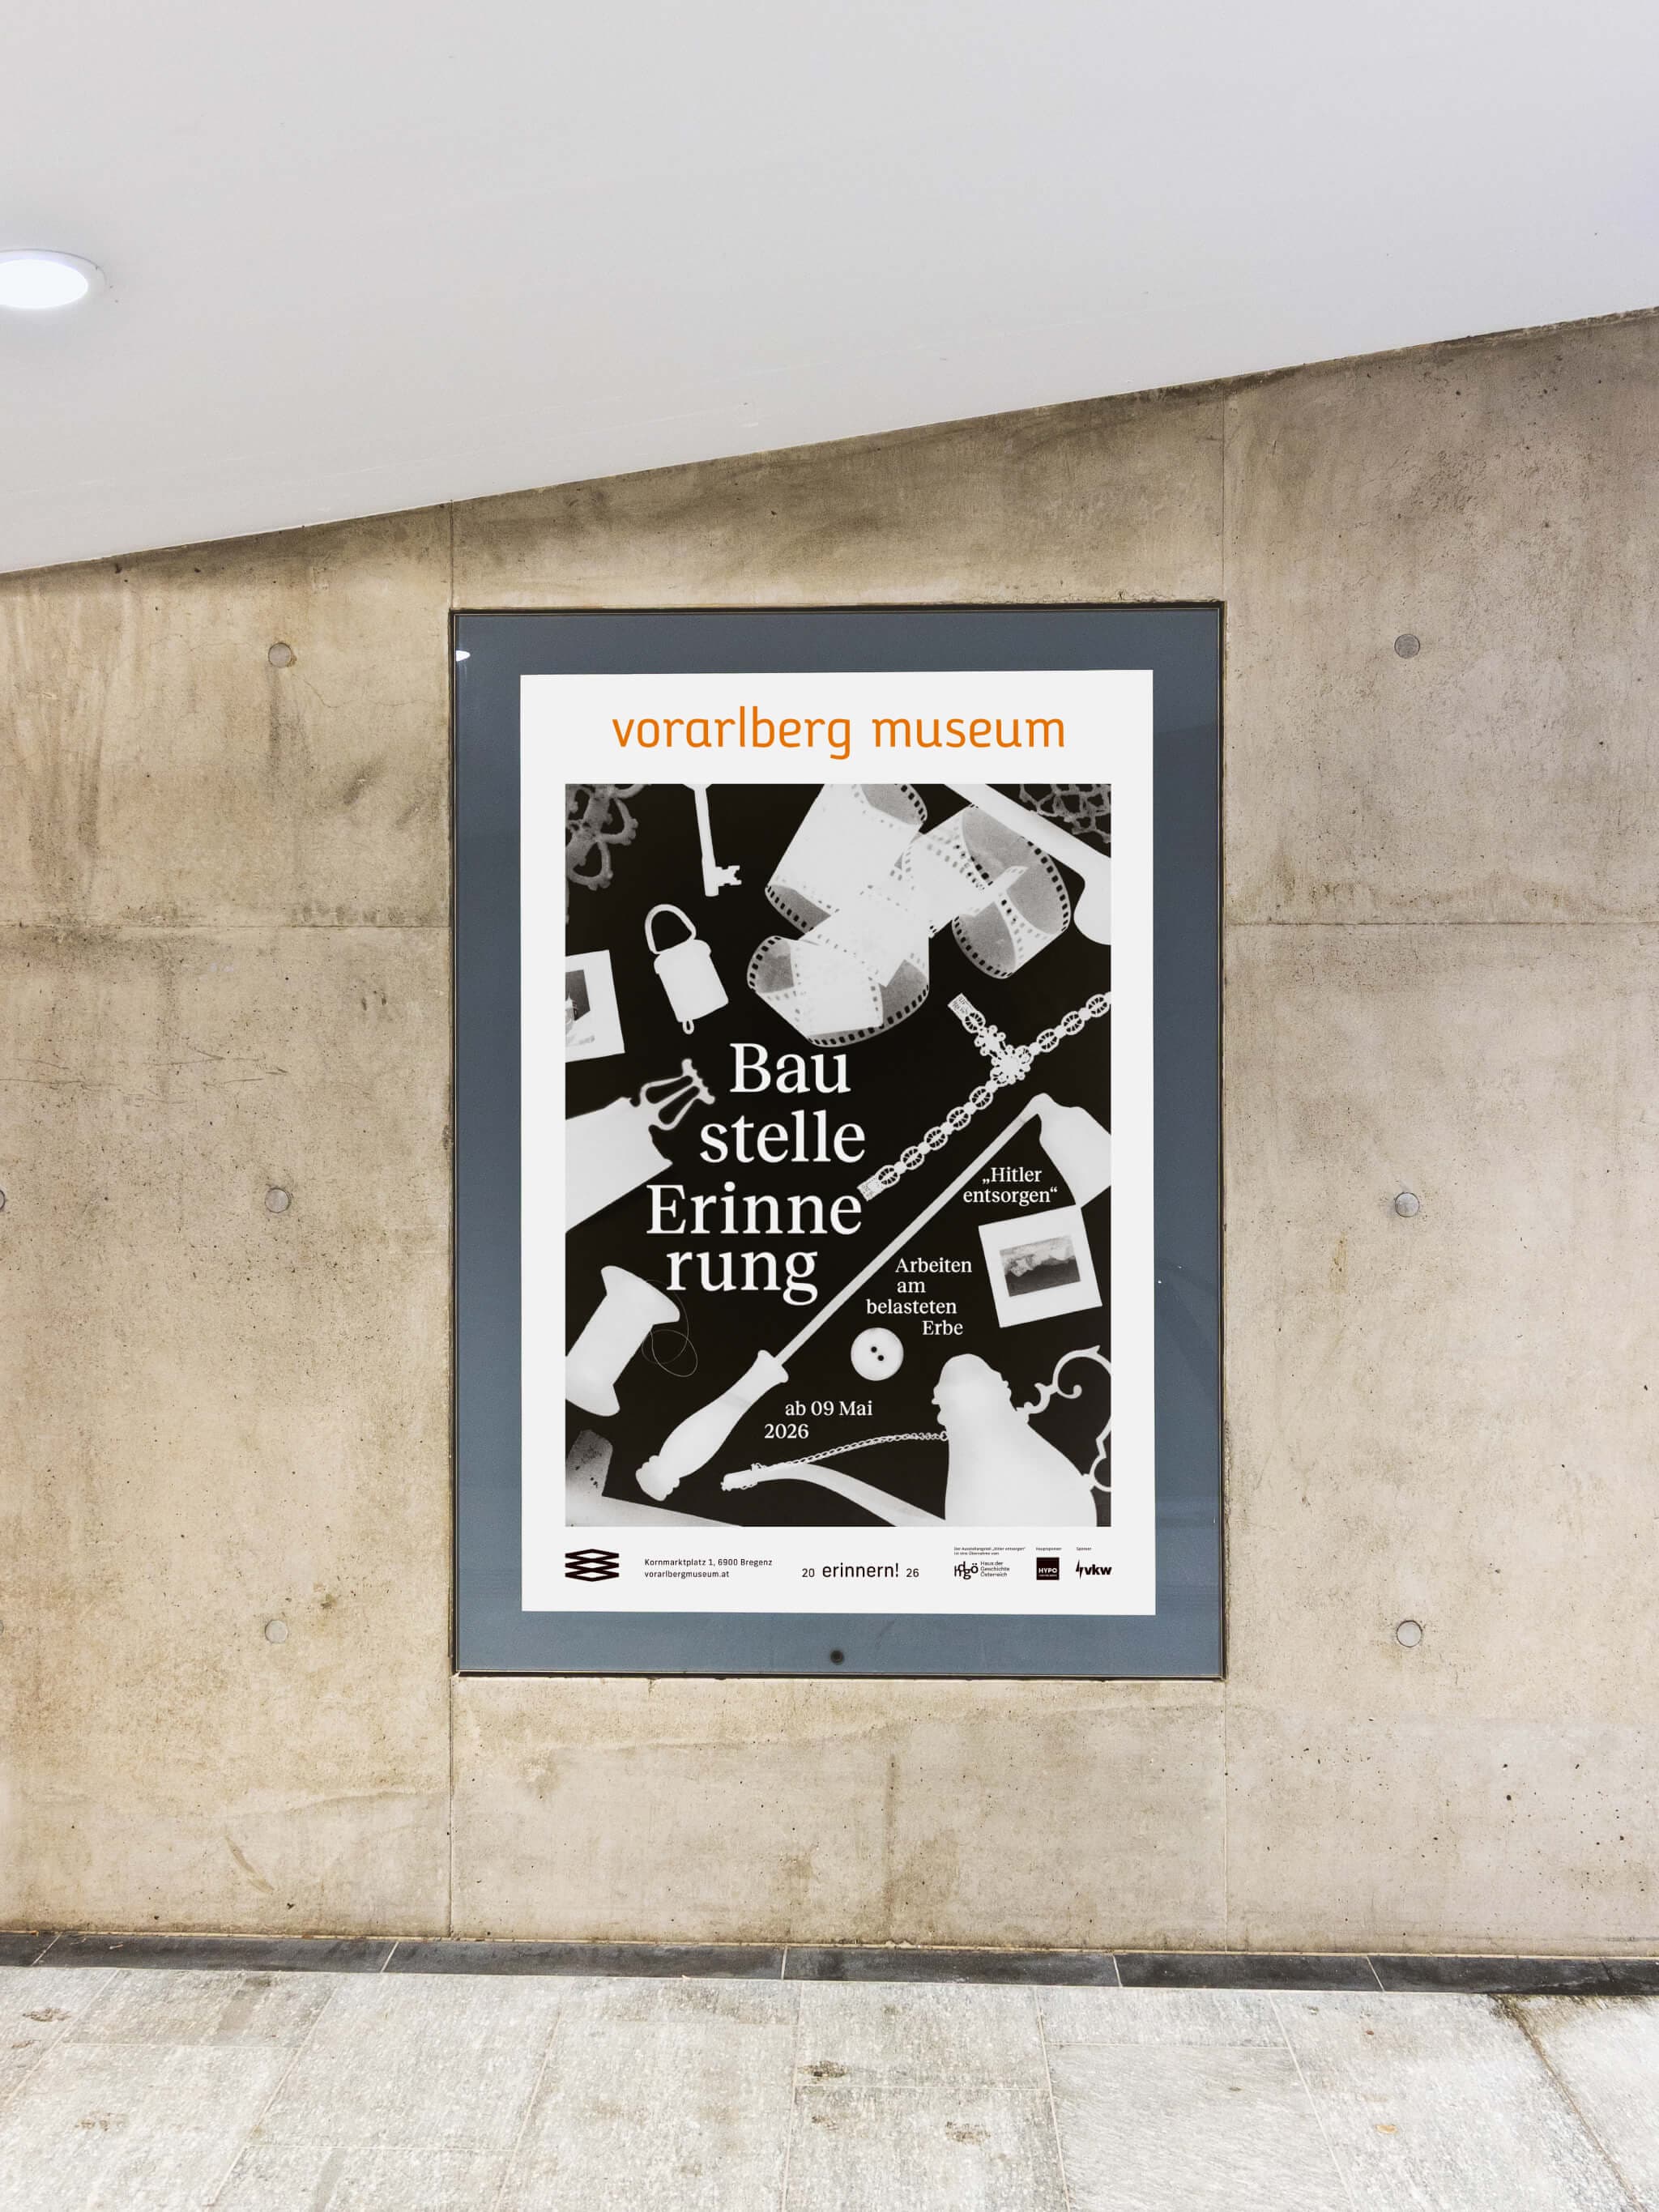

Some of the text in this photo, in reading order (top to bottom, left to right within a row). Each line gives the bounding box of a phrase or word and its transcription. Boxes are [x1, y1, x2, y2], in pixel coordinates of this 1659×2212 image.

[612, 705, 1064, 760] vorarlberg museum
[730, 1043, 851, 1093] Bau
[700, 1109, 865, 1163] stelle
[982, 1166, 1042, 1185] „Hitler
[962, 1186, 1058, 1206] entsorgen“
[646, 1181, 862, 1235] Erinne
[895, 1257, 972, 1273] Arbeiten
[667, 1250, 818, 1306] rung
[897, 1281, 926, 1294] am
[866, 1298, 957, 1315] belasteten
[922, 1319, 963, 1336] Erbe
[785, 1400, 872, 1416] ab 09 Mai
[764, 1423, 809, 1439] 2026
[645, 1558, 773, 1568] Kornmarktplatz 1, 6900 Bregenz
[802, 1562, 919, 1578] 20 erinnern! 26
[1084, 1563, 1113, 1575] vkw
[645, 1570, 730, 1579] vorarlbergmuseum.at
